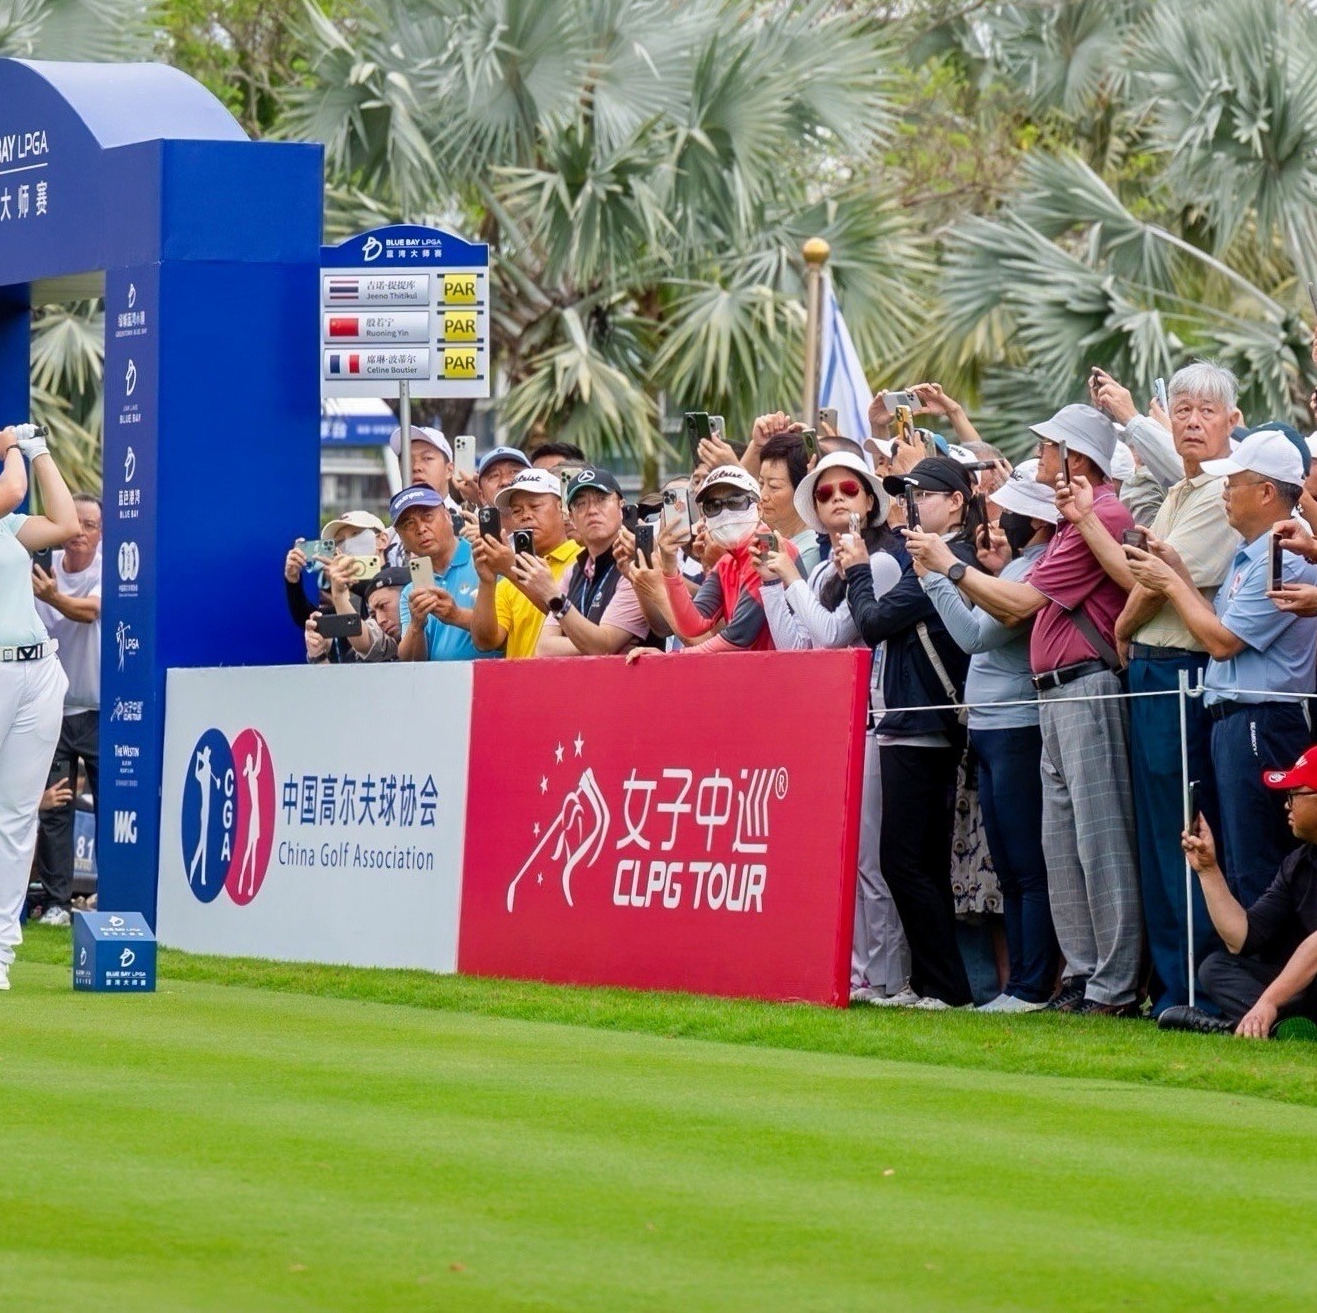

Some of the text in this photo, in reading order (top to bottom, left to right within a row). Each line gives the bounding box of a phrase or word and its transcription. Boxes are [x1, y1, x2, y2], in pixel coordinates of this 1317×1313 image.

[18, 130, 49, 158] LPGA
[386, 249, 442, 258] 蓝湾大师赛
[367, 292, 417, 300] Jeeno Thitikul
[444, 282, 475, 296] PAR
[444, 319, 476, 333] PAR
[366, 330, 396, 338] Ruoning
[391, 366, 417, 374] Boutier
[444, 356, 476, 370] PAR
[119, 413, 141, 424] BLUE BAY
[118, 489, 140, 506] 蓝色港湾
[119, 510, 139, 519] BLUE BAY
[125, 638, 140, 651] LPGA
[282, 773, 439, 827] 中国高尔夫球协会
[221, 768, 234, 862] CGA
[114, 810, 137, 844] IMG
[76, 835, 95, 861] 81
[278, 841, 434, 871] China Golf Association
[613, 859, 767, 913] CLPG TOUR
